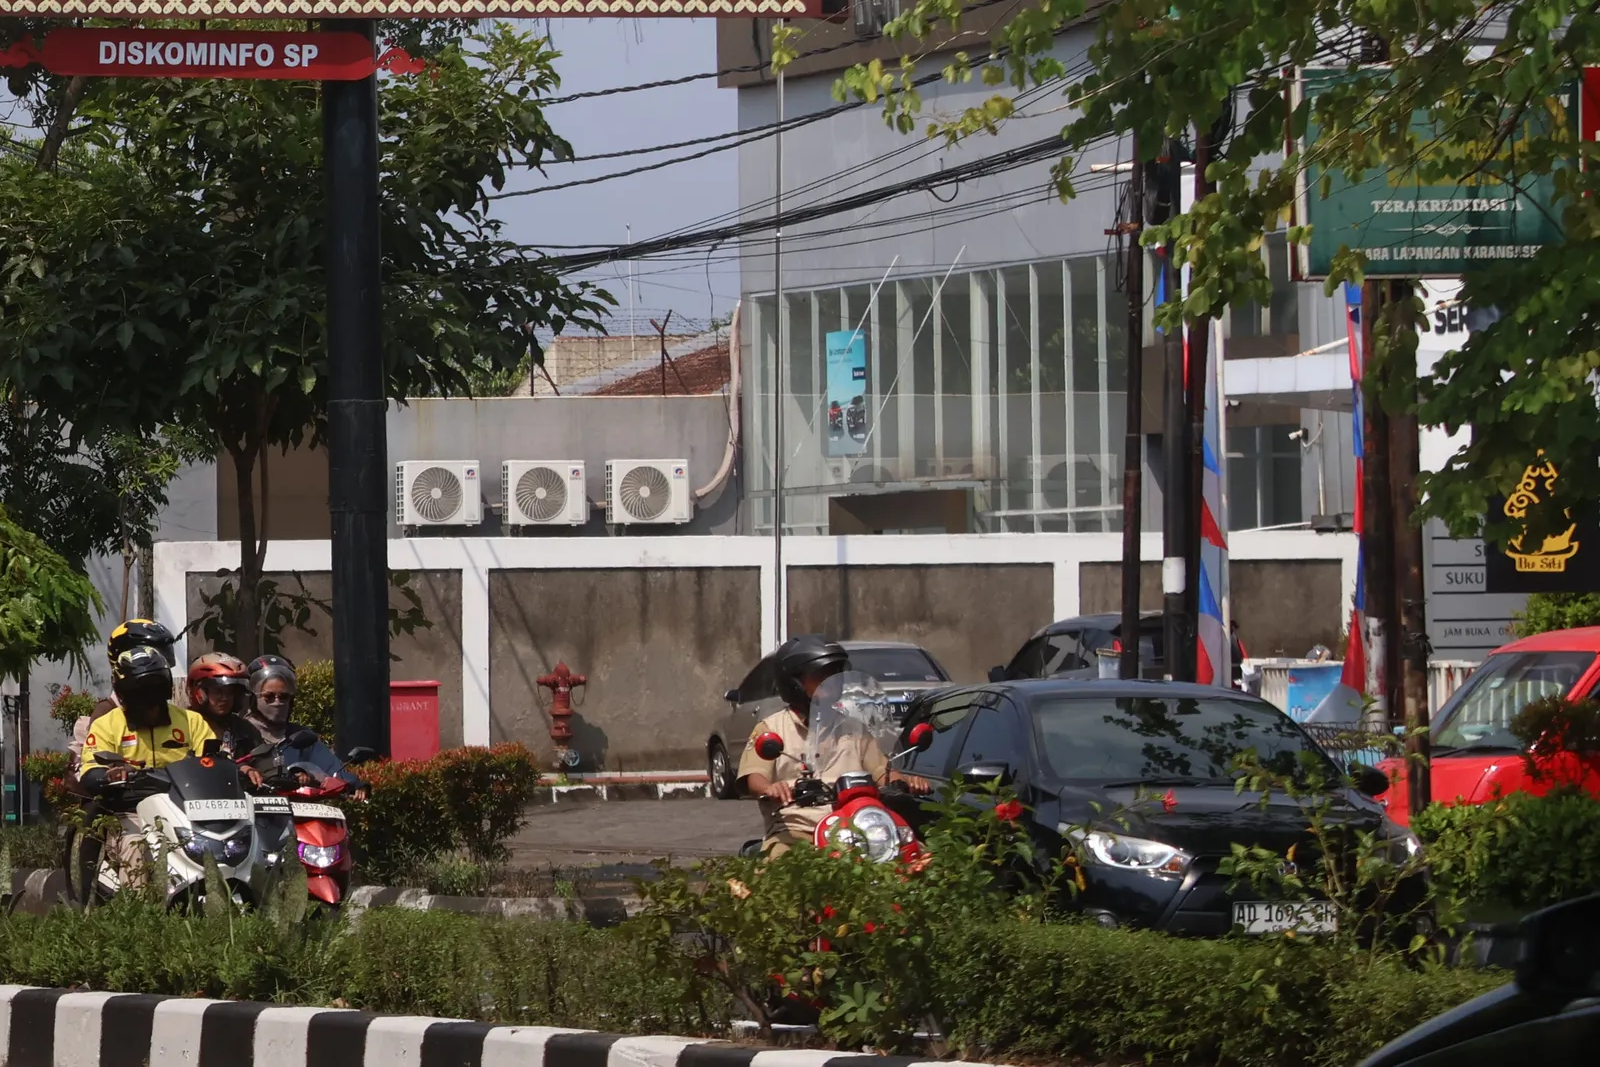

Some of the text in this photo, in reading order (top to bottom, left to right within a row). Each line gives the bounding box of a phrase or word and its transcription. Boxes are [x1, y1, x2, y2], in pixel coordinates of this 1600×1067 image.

[99, 40, 320, 68] DISKOMINFO SP
[1370, 197, 1507, 213] TERAKREDITASI
[1393, 246, 1460, 261] LAPANGAN
[1444, 627, 1462, 638] JAM
[1465, 627, 1491, 637] BUKA
[188, 800, 201, 810] AD
[205, 800, 229, 809] 4682
[1236, 903, 1257, 922] AD
